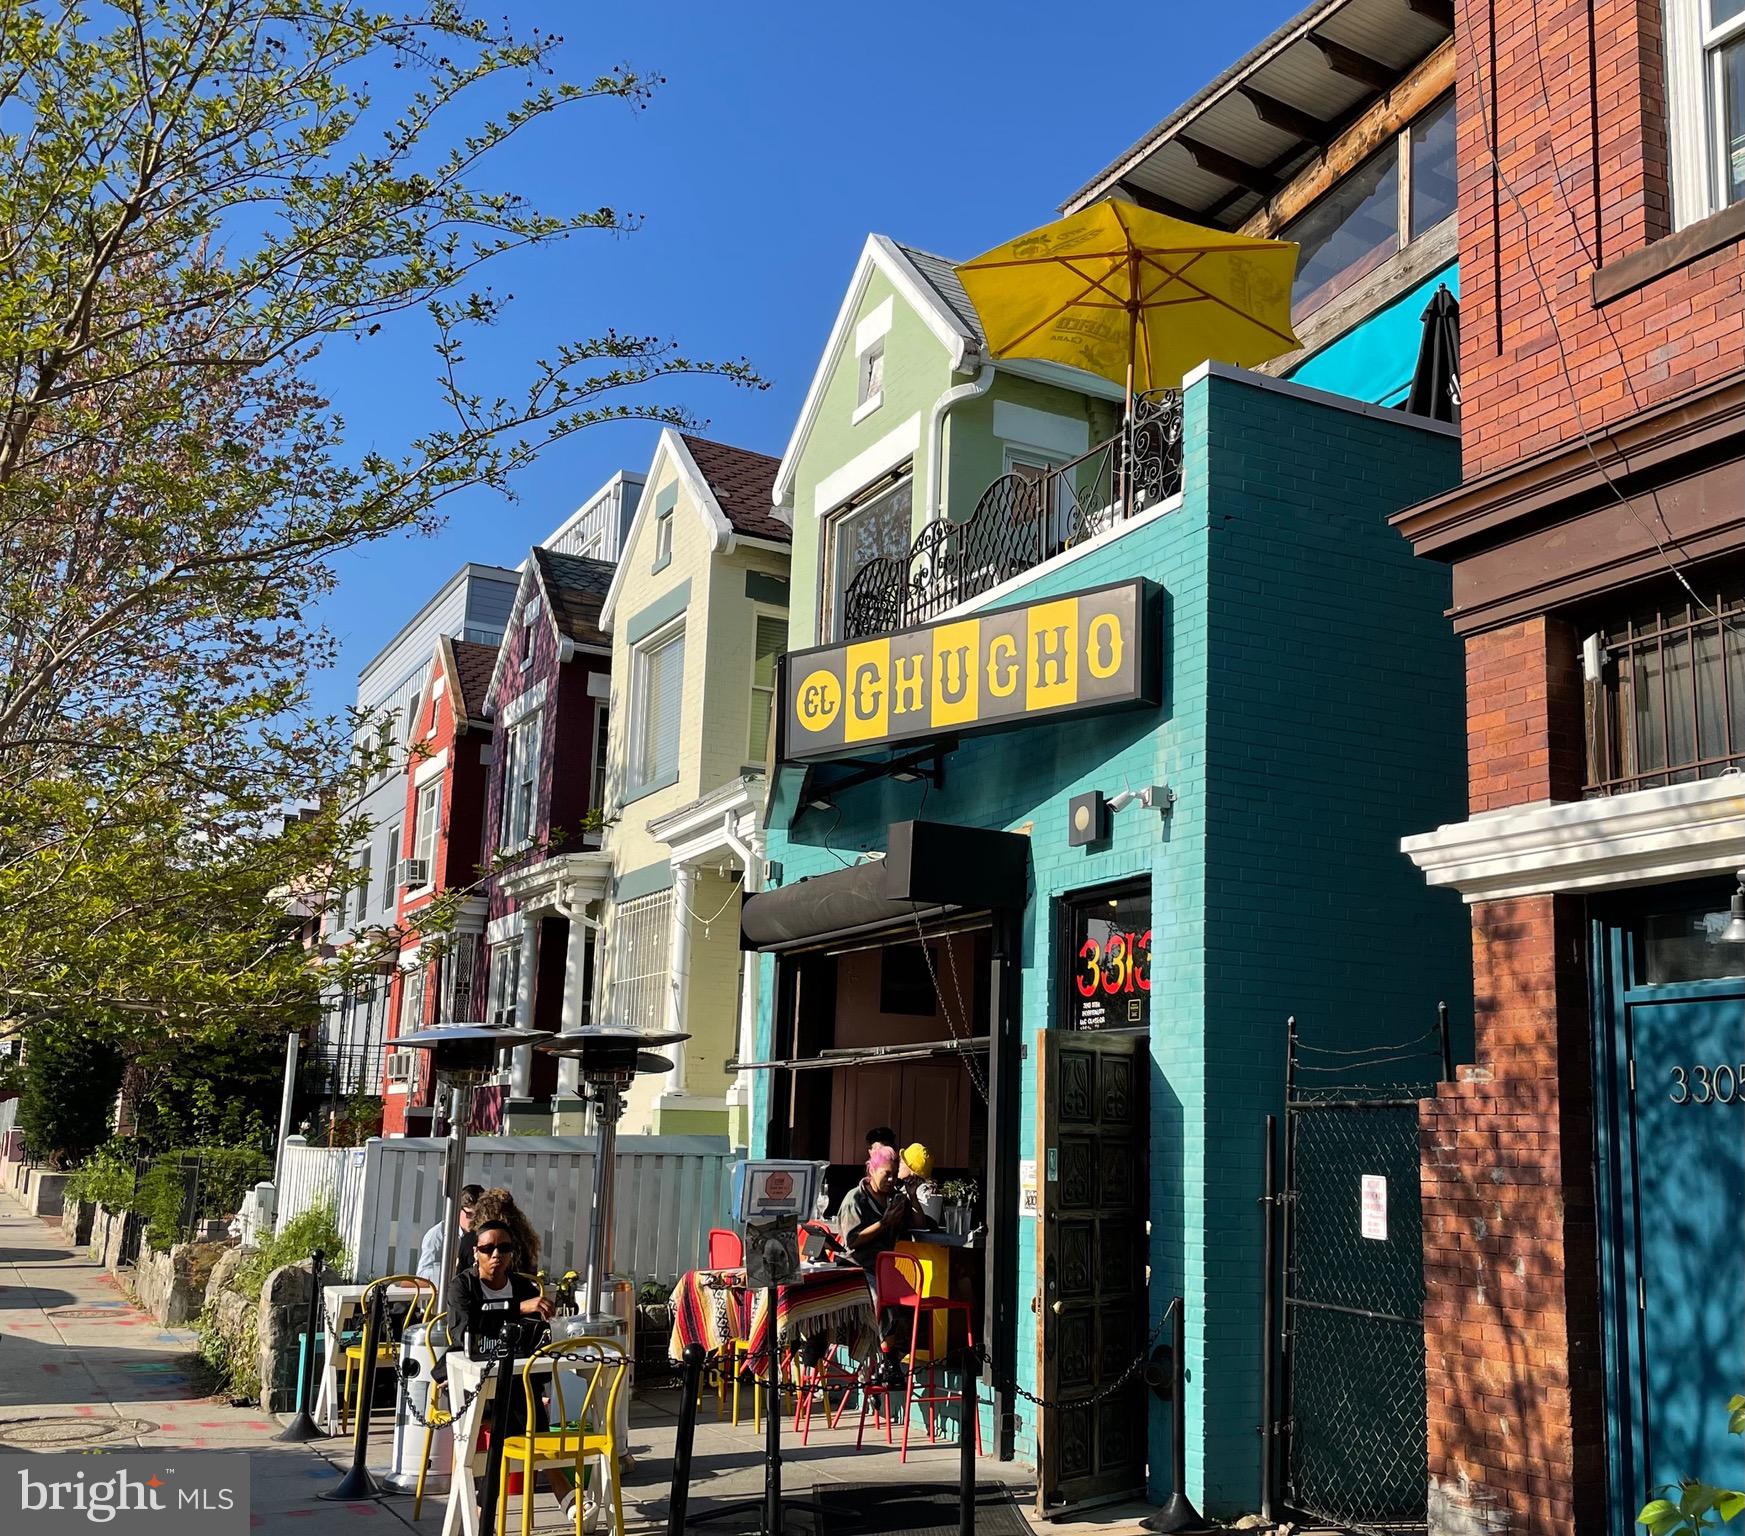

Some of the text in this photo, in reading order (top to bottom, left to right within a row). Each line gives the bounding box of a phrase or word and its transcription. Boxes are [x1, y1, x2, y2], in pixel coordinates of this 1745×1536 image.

[803, 613, 1125, 721] EL CHUCHO
[1076, 929, 1151, 997] 3313
